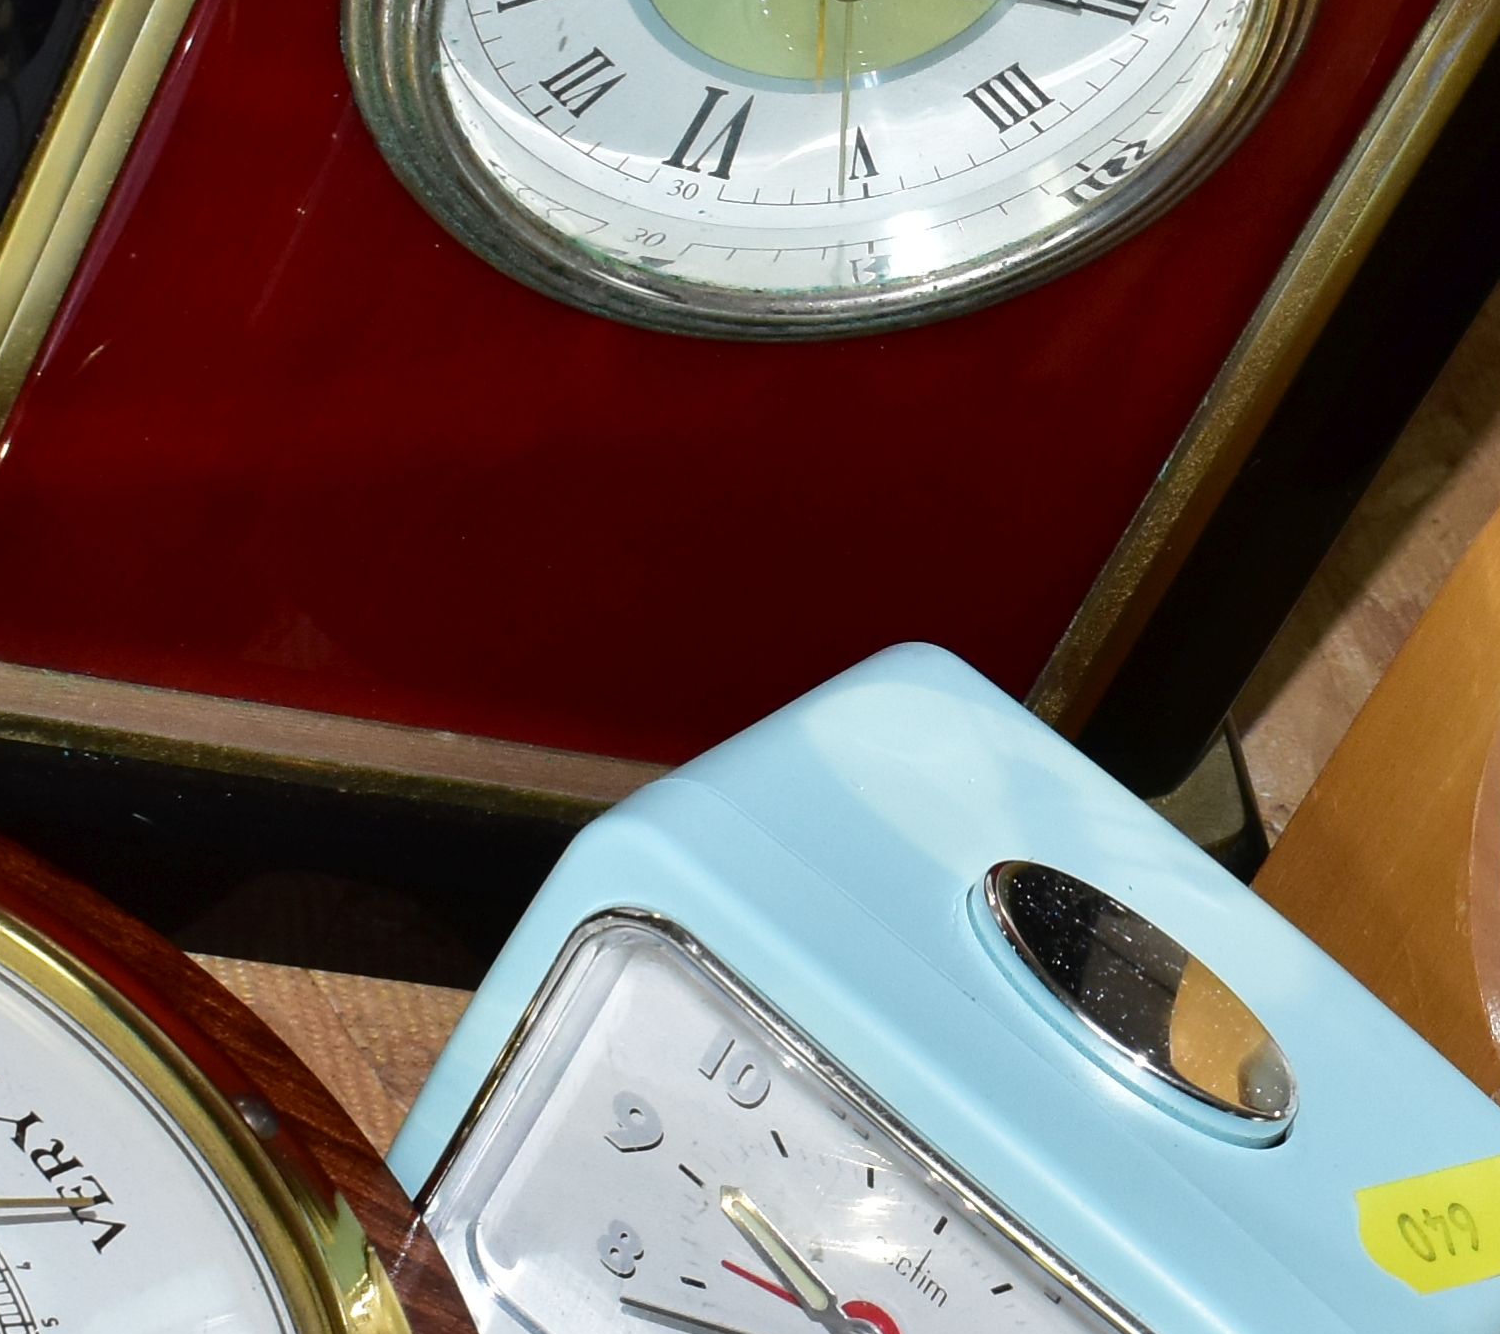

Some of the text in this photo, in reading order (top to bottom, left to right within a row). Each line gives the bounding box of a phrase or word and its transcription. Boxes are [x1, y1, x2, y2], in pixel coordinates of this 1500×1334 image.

[1150, 3, 1176, 25] 15
[539, 48, 625, 119] VII
[963, 62, 1055, 134] IIII
[662, 86, 756, 180] VI
[850, 125, 881, 181] V
[666, 179, 700, 200] 30
[698, 1025, 771, 1109] 10
[604, 1090, 664, 1153] 9
[597, 1219, 644, 1279] 8
[1398, 1202, 1480, 1266] 640
